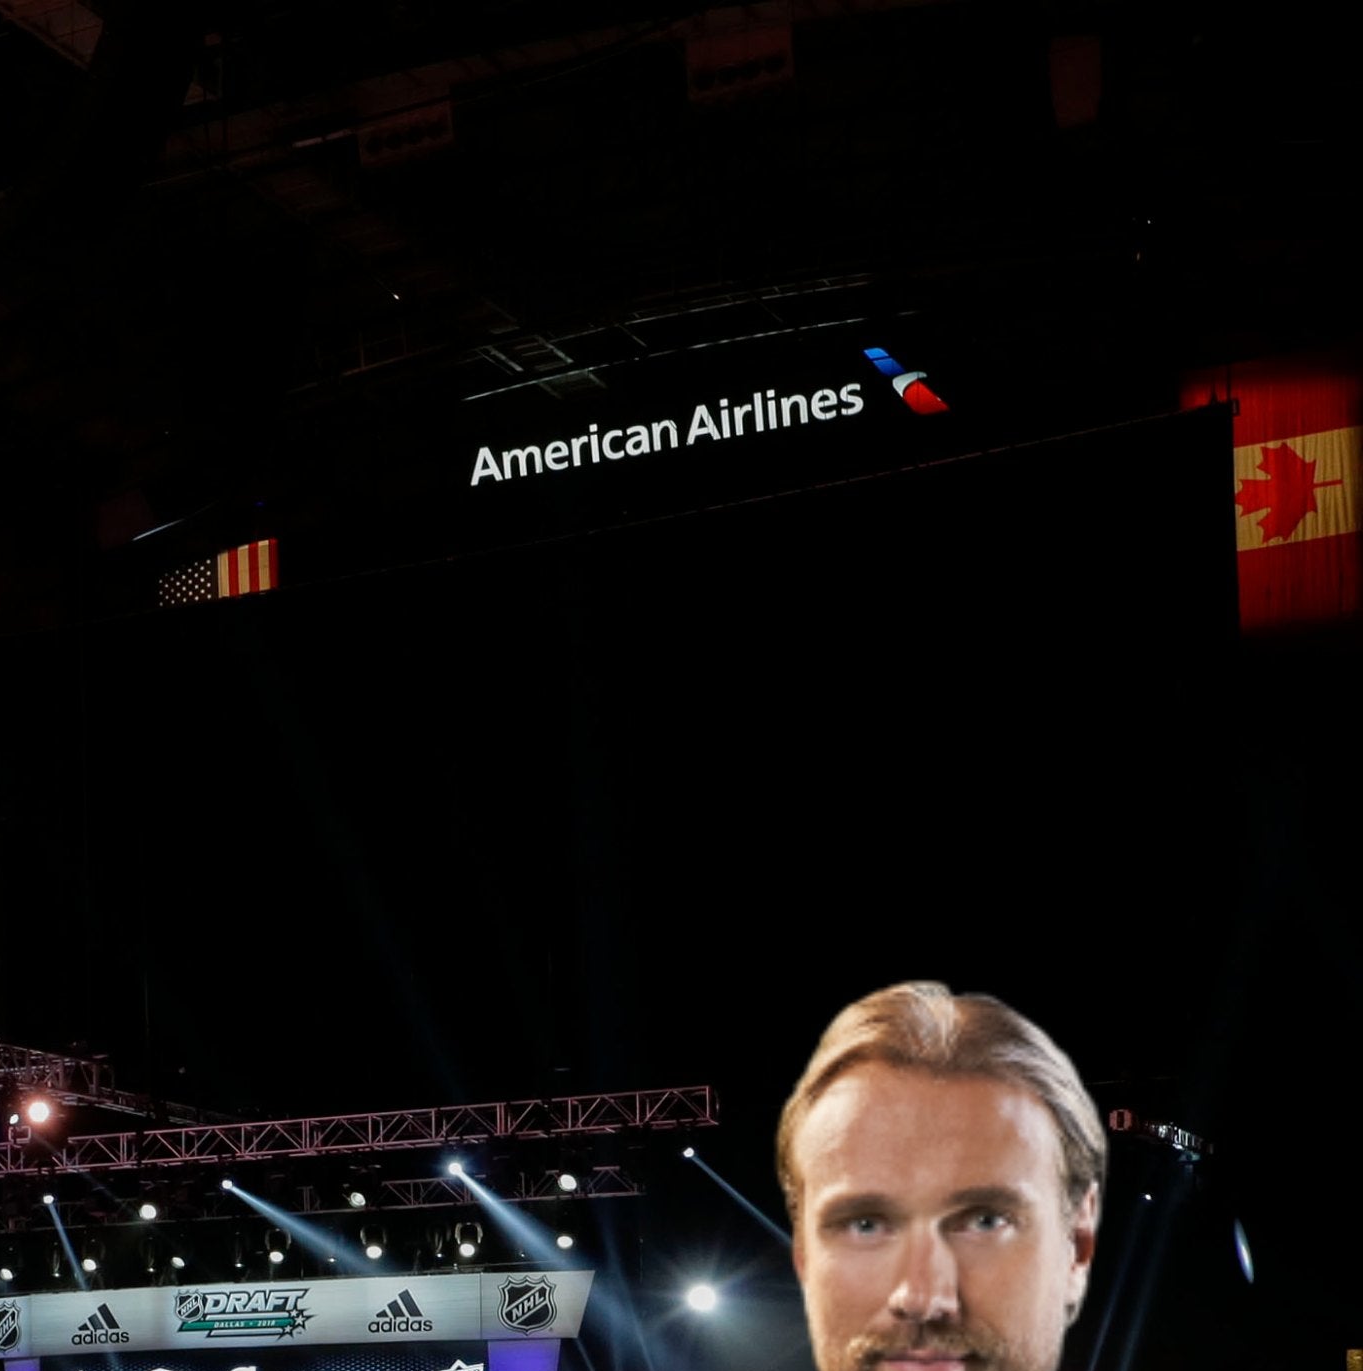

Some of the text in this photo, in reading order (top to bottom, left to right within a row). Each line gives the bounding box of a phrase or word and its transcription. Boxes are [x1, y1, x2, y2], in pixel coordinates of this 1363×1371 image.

[470, 381, 864, 485] American Airlines
[179, 1296, 201, 1315] NHL
[204, 1290, 309, 1313] DRAFT
[508, 1290, 545, 1319] NHL
[368, 1317, 433, 1333] adidas
[72, 1329, 129, 1345] adidas
